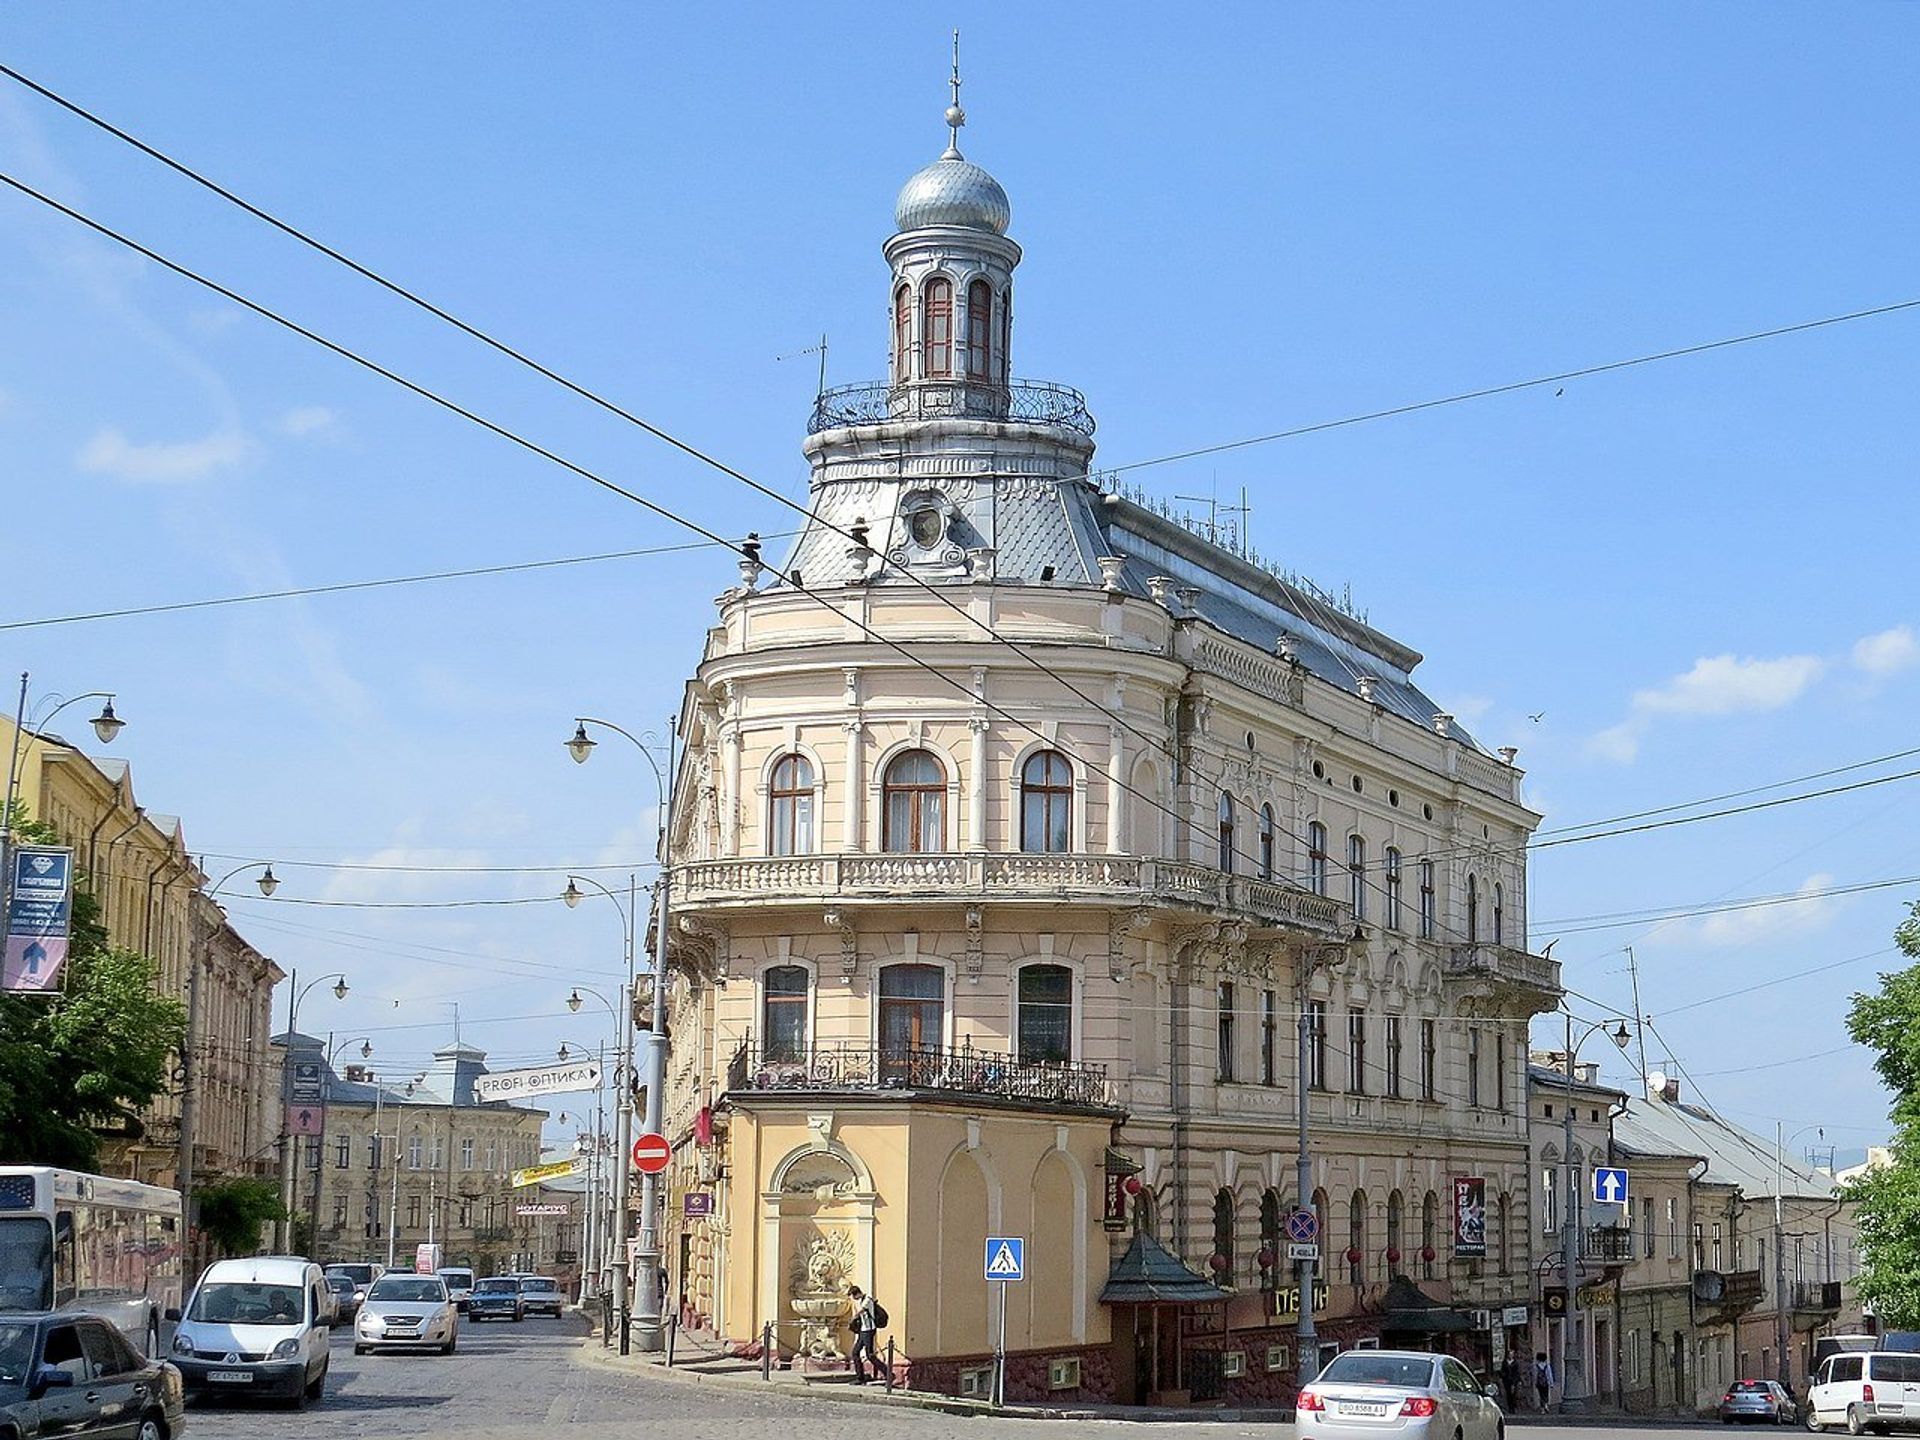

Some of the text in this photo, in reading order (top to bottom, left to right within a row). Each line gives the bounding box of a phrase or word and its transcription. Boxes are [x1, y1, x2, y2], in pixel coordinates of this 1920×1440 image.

[483, 1077, 523, 1092] PROFI
[528, 1070, 587, 1087] ОПТИКА
[1274, 1285, 1329, 1315] ПЕІН
